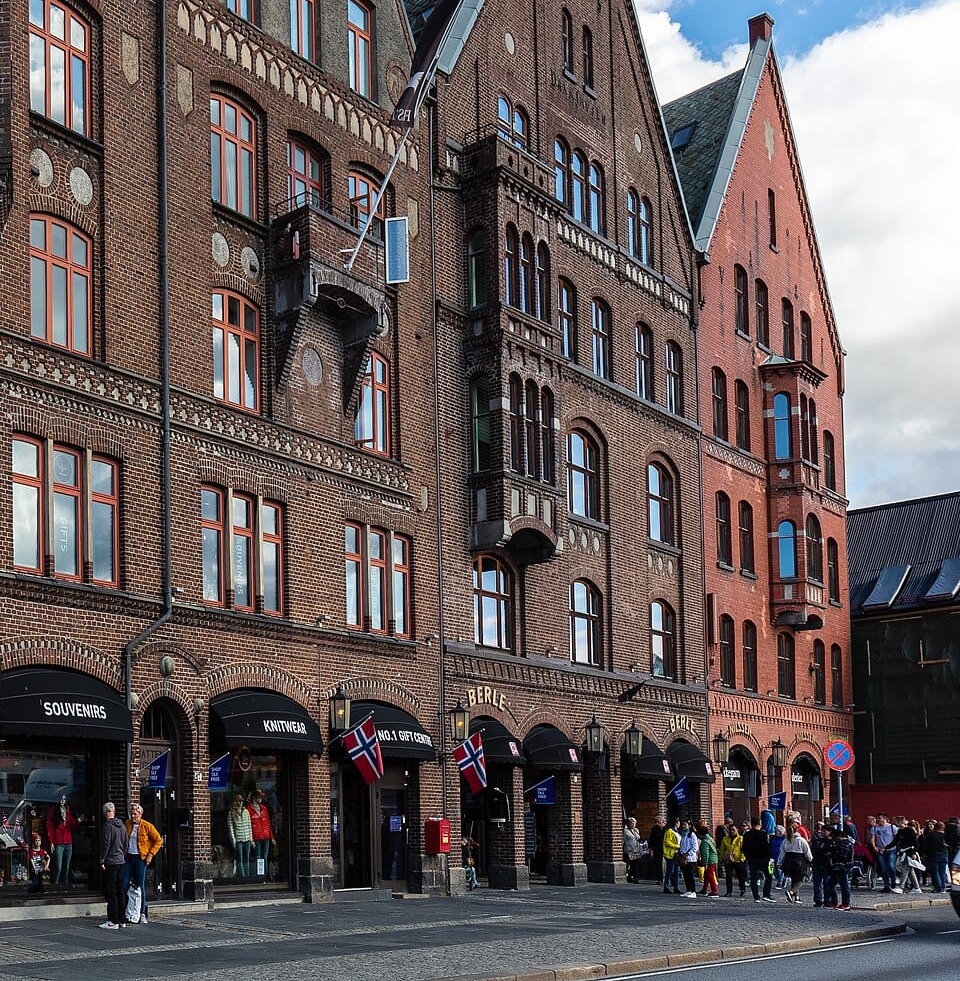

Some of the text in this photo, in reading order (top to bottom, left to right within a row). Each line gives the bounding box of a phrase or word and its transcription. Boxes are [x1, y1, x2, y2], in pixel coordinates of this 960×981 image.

[60, 517, 69, 552] GIFTS
[236, 538, 245, 595] SOUVENIRS
[467, 686, 507, 711] BERLE
[43, 701, 107, 720] SOUVENIRS
[263, 719, 308, 735] KNITWEAR
[670, 715, 696, 733] BERLE
[377, 730, 398, 741] NO.1
